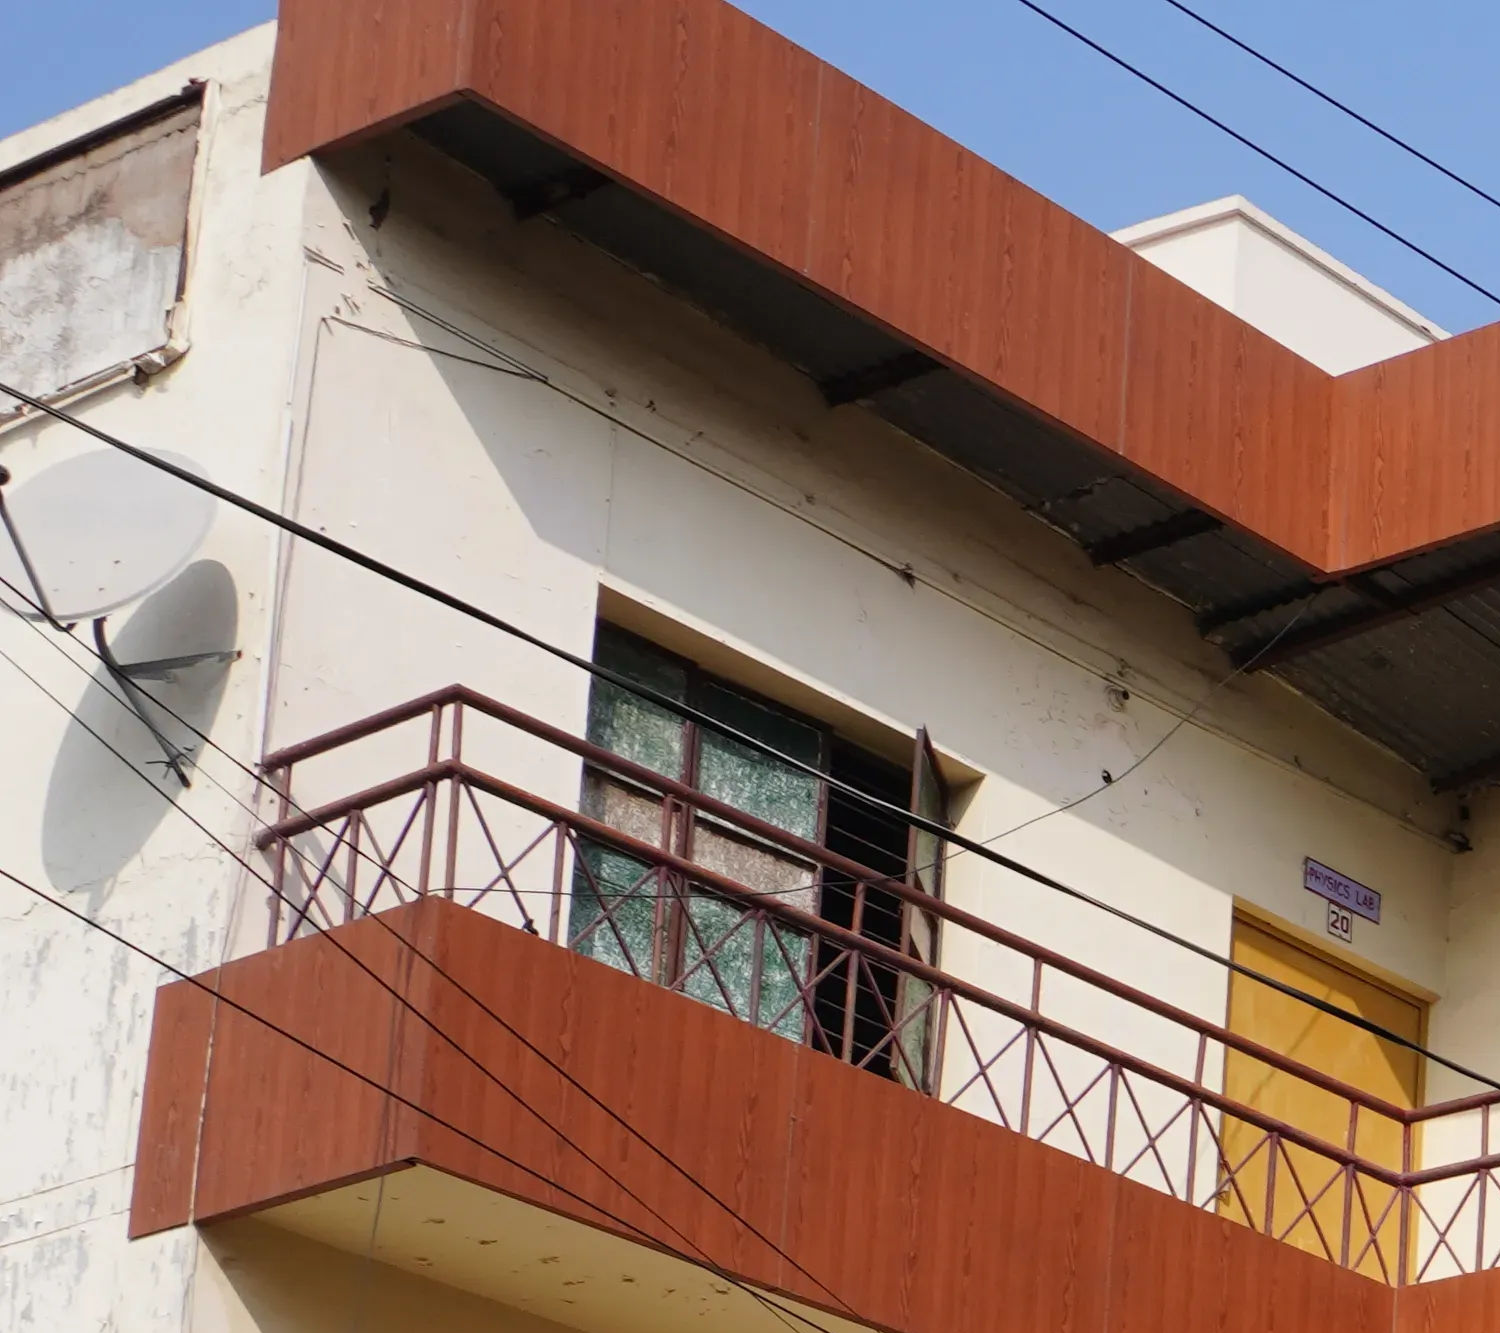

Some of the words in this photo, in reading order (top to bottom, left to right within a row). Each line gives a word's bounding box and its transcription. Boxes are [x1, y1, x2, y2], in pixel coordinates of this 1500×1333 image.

[1309, 866, 1350, 899] PHYSICS
[1356, 890, 1375, 911] LAB
[1330, 910, 1349, 934] 20
